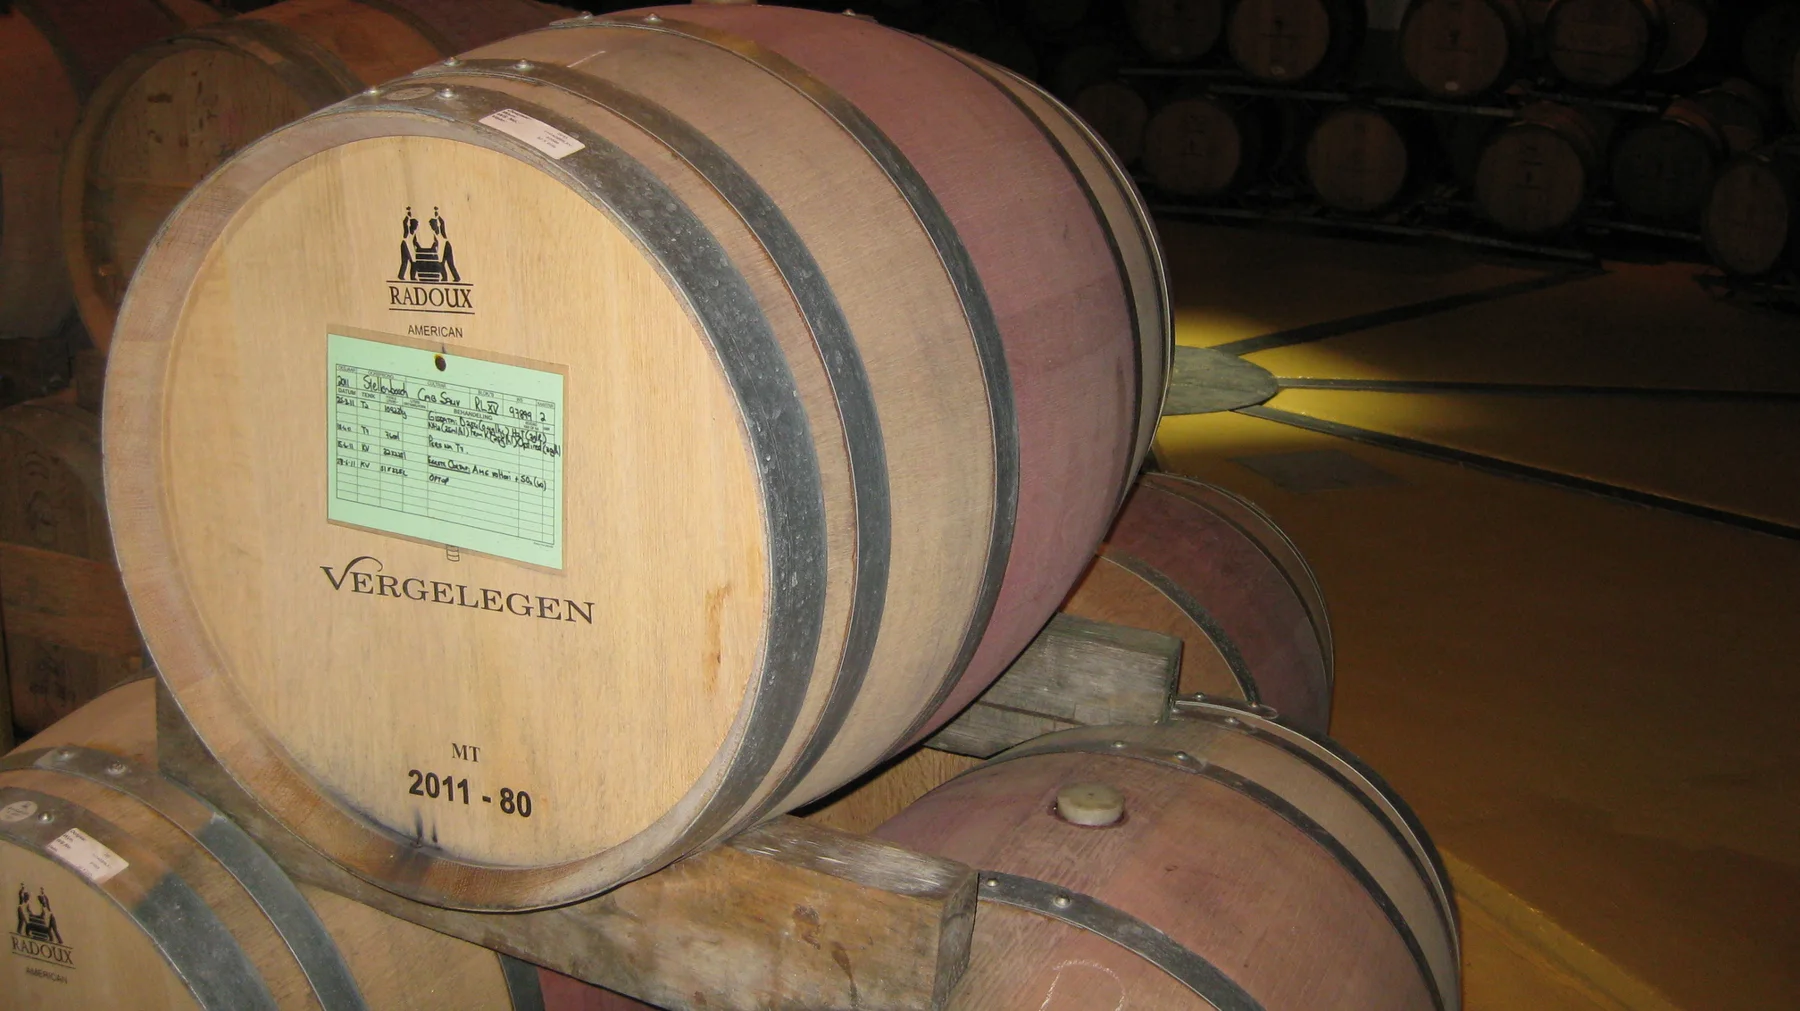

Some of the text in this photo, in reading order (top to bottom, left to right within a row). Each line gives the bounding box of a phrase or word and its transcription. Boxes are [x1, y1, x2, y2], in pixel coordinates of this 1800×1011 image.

[388, 285, 474, 309] RADOUX
[407, 324, 464, 338] AMERICAN
[453, 408, 493, 420] BEHANDELING
[319, 555, 596, 625] VERGELEGEN
[451, 742, 480, 763] MT
[408, 769, 470, 805] 2011
[499, 787, 532, 818] 80
[11, 935, 75, 965] RADOUX
[26, 966, 68, 984] AMERICAN
